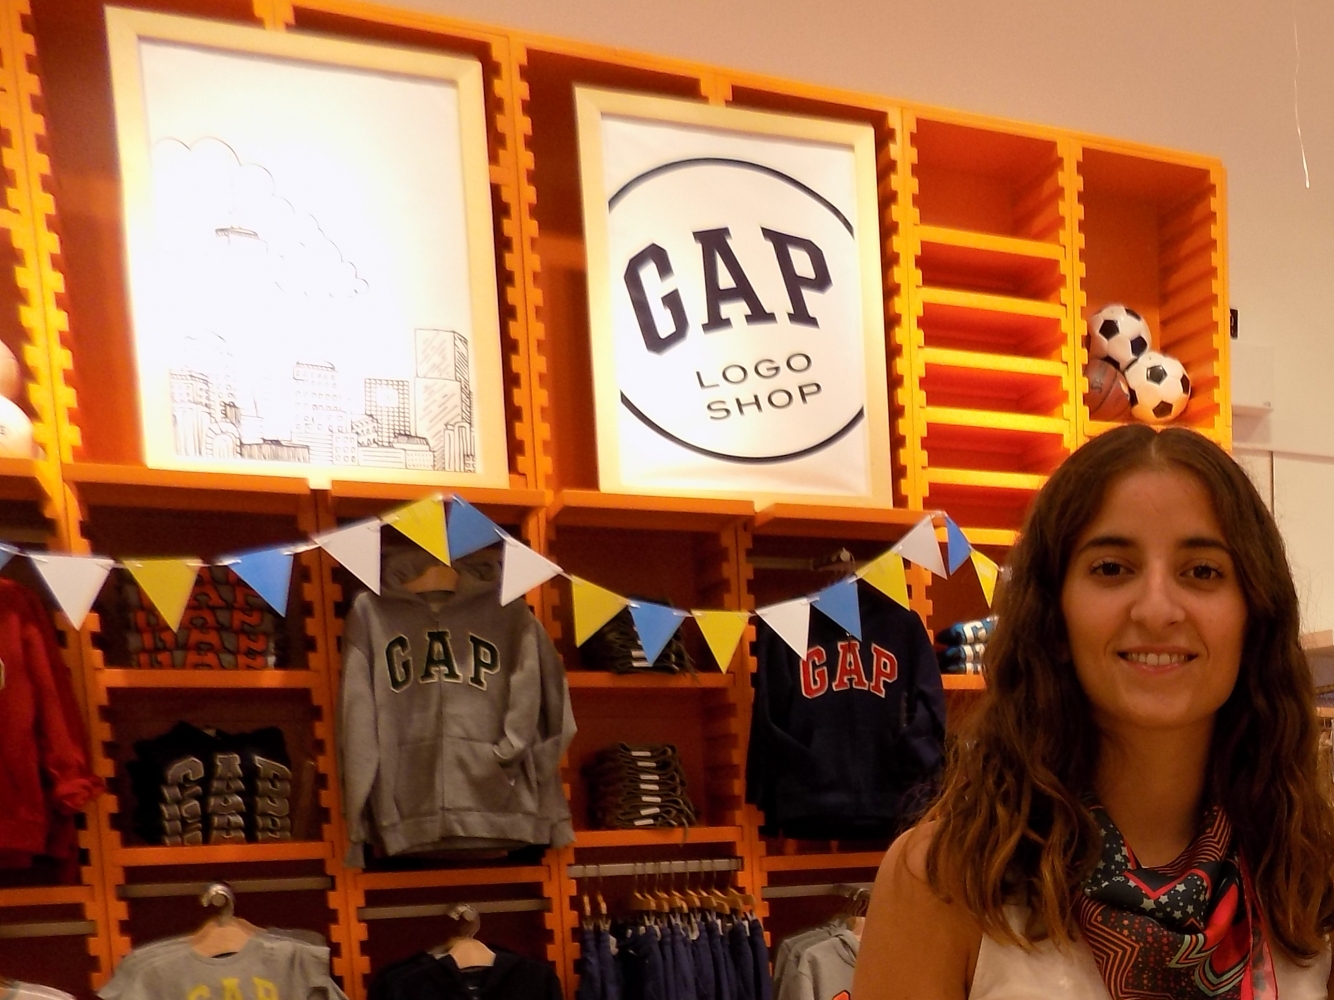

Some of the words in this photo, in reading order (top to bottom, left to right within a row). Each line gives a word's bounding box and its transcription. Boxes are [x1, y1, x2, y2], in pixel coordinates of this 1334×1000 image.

[624, 226, 834, 356] GAP
[696, 353, 812, 389] LOGO
[706, 382, 823, 420] SHOP
[385, 629, 501, 693] GAP
[800, 641, 898, 699] GAP
